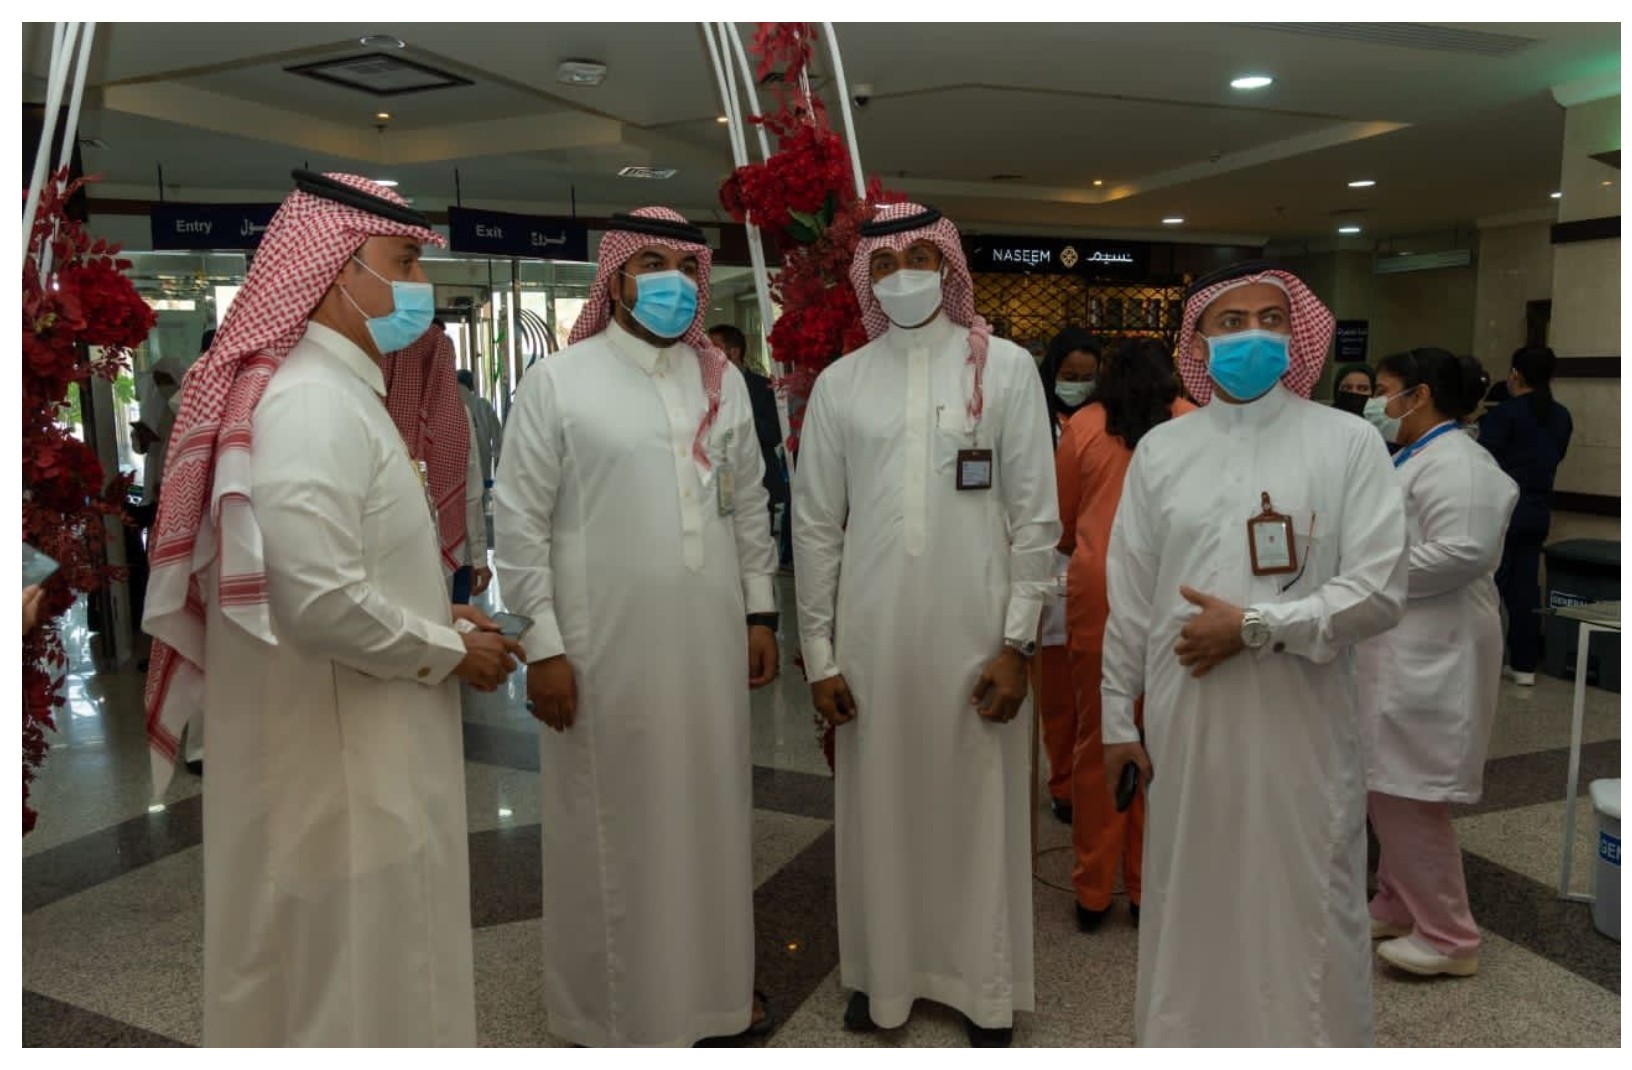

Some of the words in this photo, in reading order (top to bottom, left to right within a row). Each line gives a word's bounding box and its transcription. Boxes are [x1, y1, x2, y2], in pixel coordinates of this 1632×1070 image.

[175, 219, 213, 234] Entry
[475, 223, 503, 239] Exit
[992, 248, 1051, 263] NASEEM
